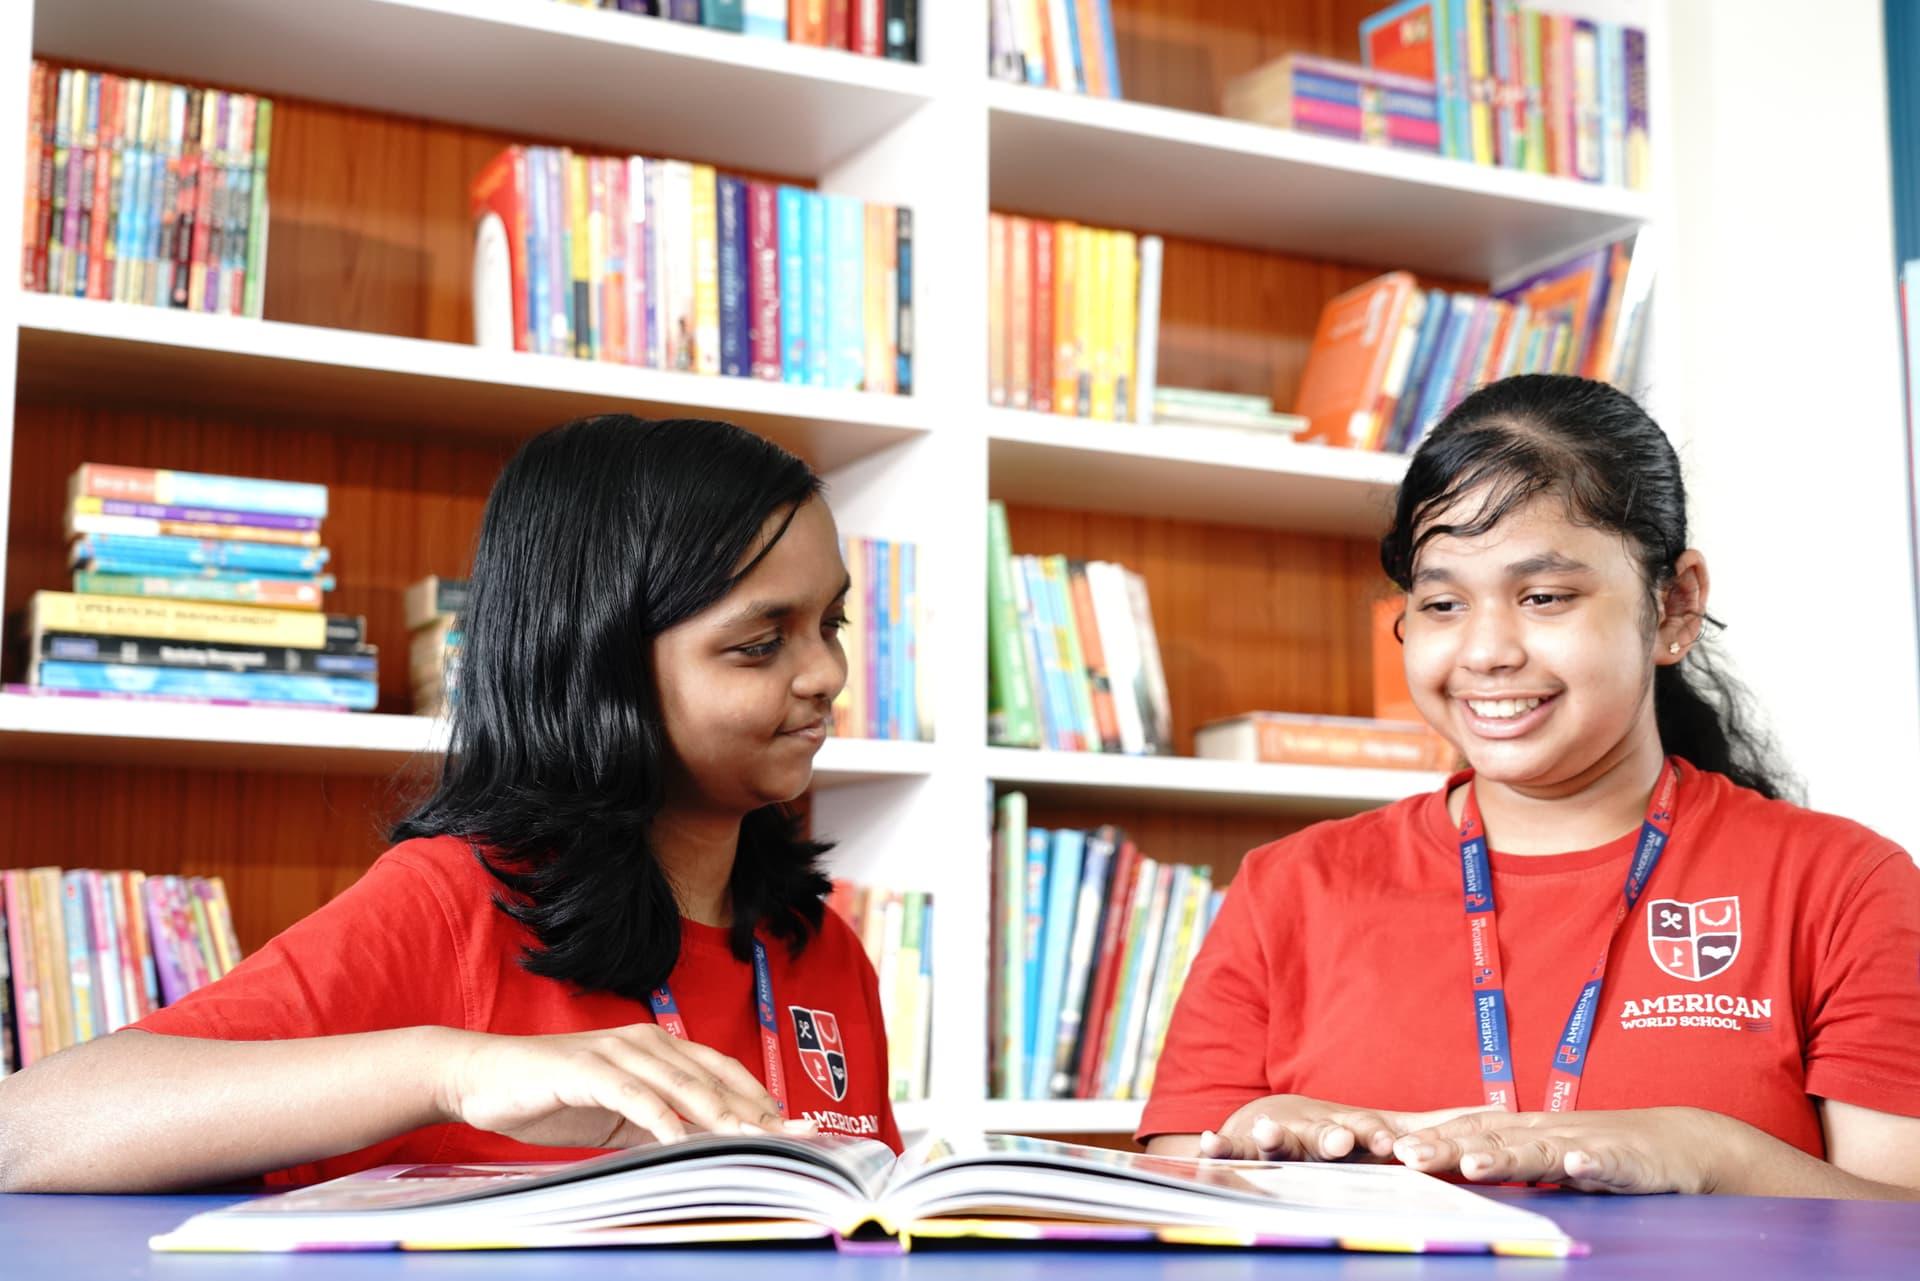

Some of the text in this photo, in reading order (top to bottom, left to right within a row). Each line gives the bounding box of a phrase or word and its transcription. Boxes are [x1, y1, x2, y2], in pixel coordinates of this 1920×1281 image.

[1463, 845, 1477, 892] AMERICAN
[1634, 831, 1657, 881] AMERICAN
[1471, 918, 1485, 967] AMERICAN
[1479, 996, 1494, 1052] AMERICAN
[1566, 986, 1593, 1044] AMERICAN
[1620, 993, 1772, 1018] AMERICAN
[1621, 1016, 1741, 1031] WORLD SCHOOL
[766, 1035, 779, 1096] AMERICAN
[801, 1110, 879, 1134] AMERICAN
